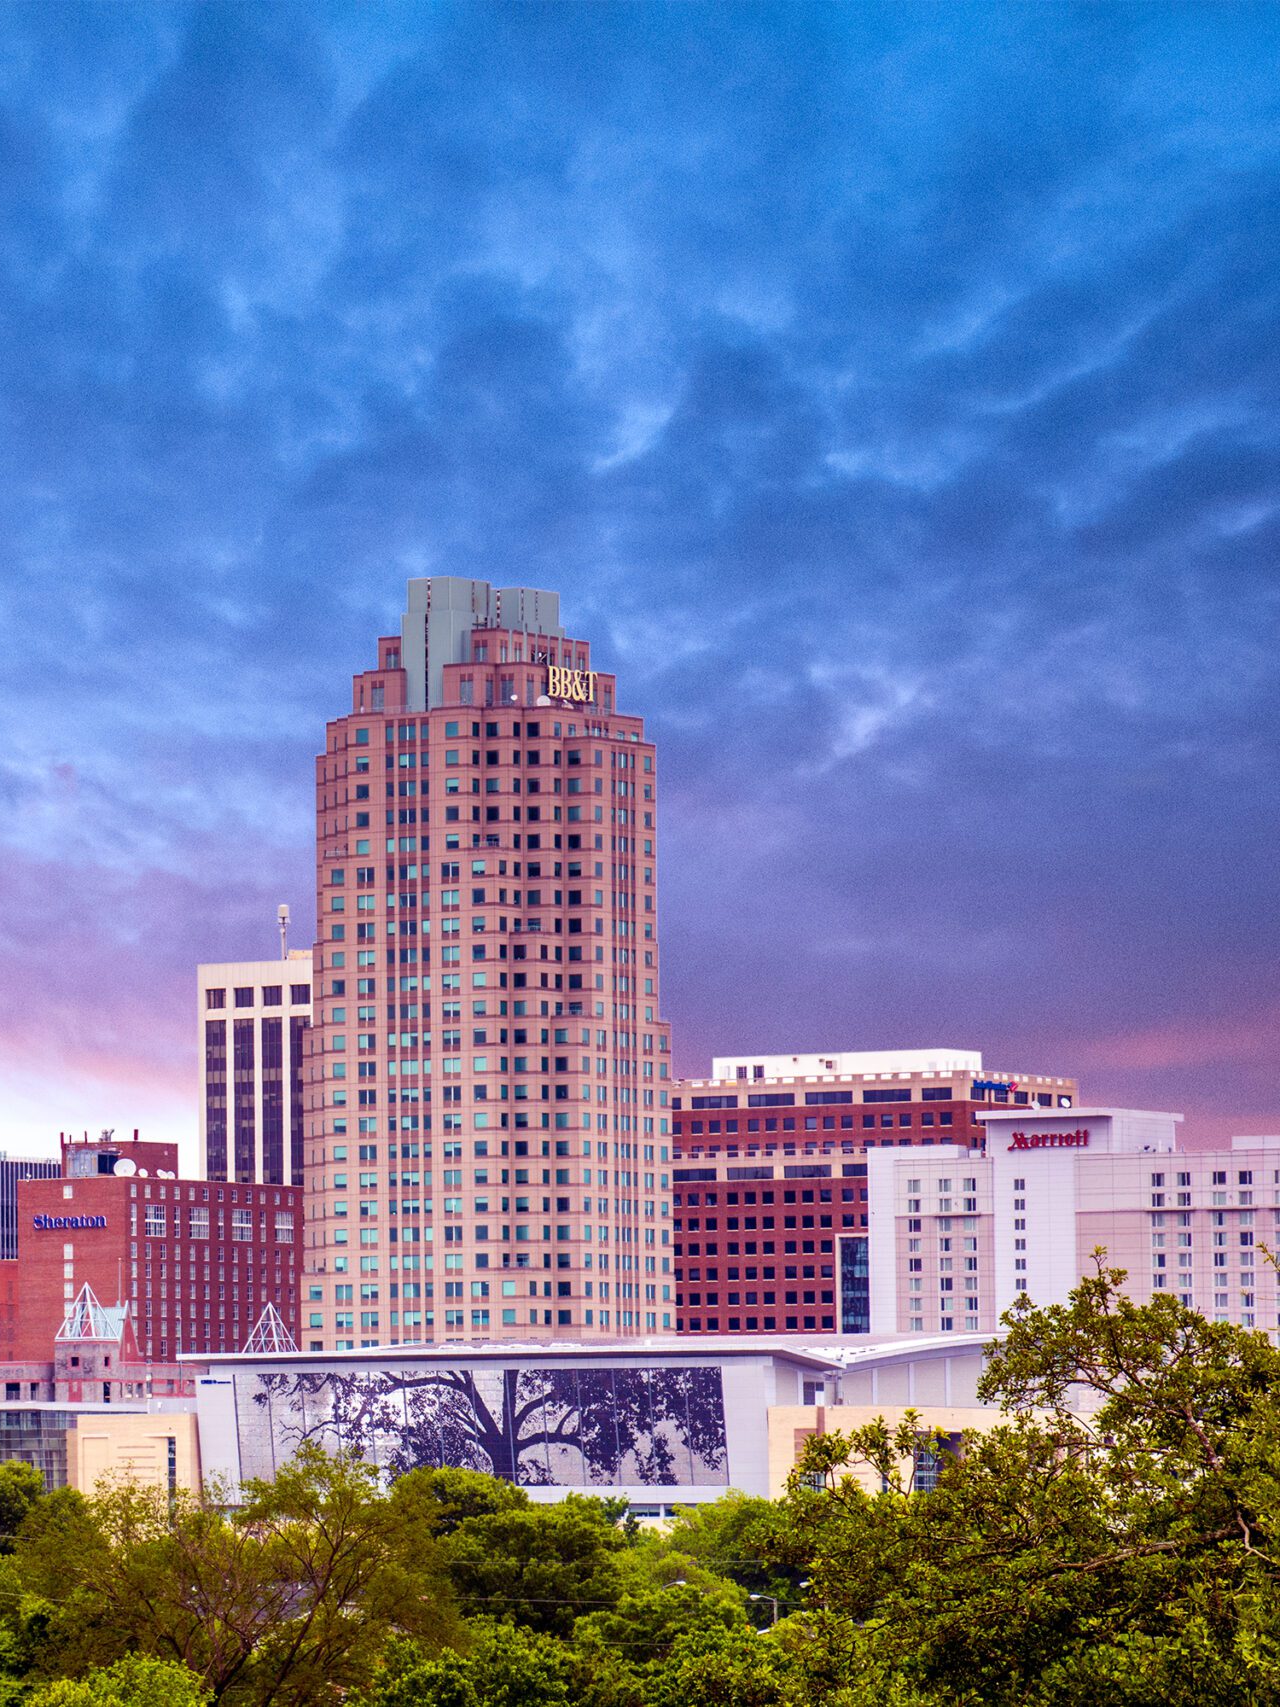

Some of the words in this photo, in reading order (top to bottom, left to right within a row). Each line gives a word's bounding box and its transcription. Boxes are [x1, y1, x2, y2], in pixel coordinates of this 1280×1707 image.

[548, 666, 598, 702] BB&T
[1007, 1129, 1089, 1151] Marriott
[33, 1213, 107, 1230] Sheraton
